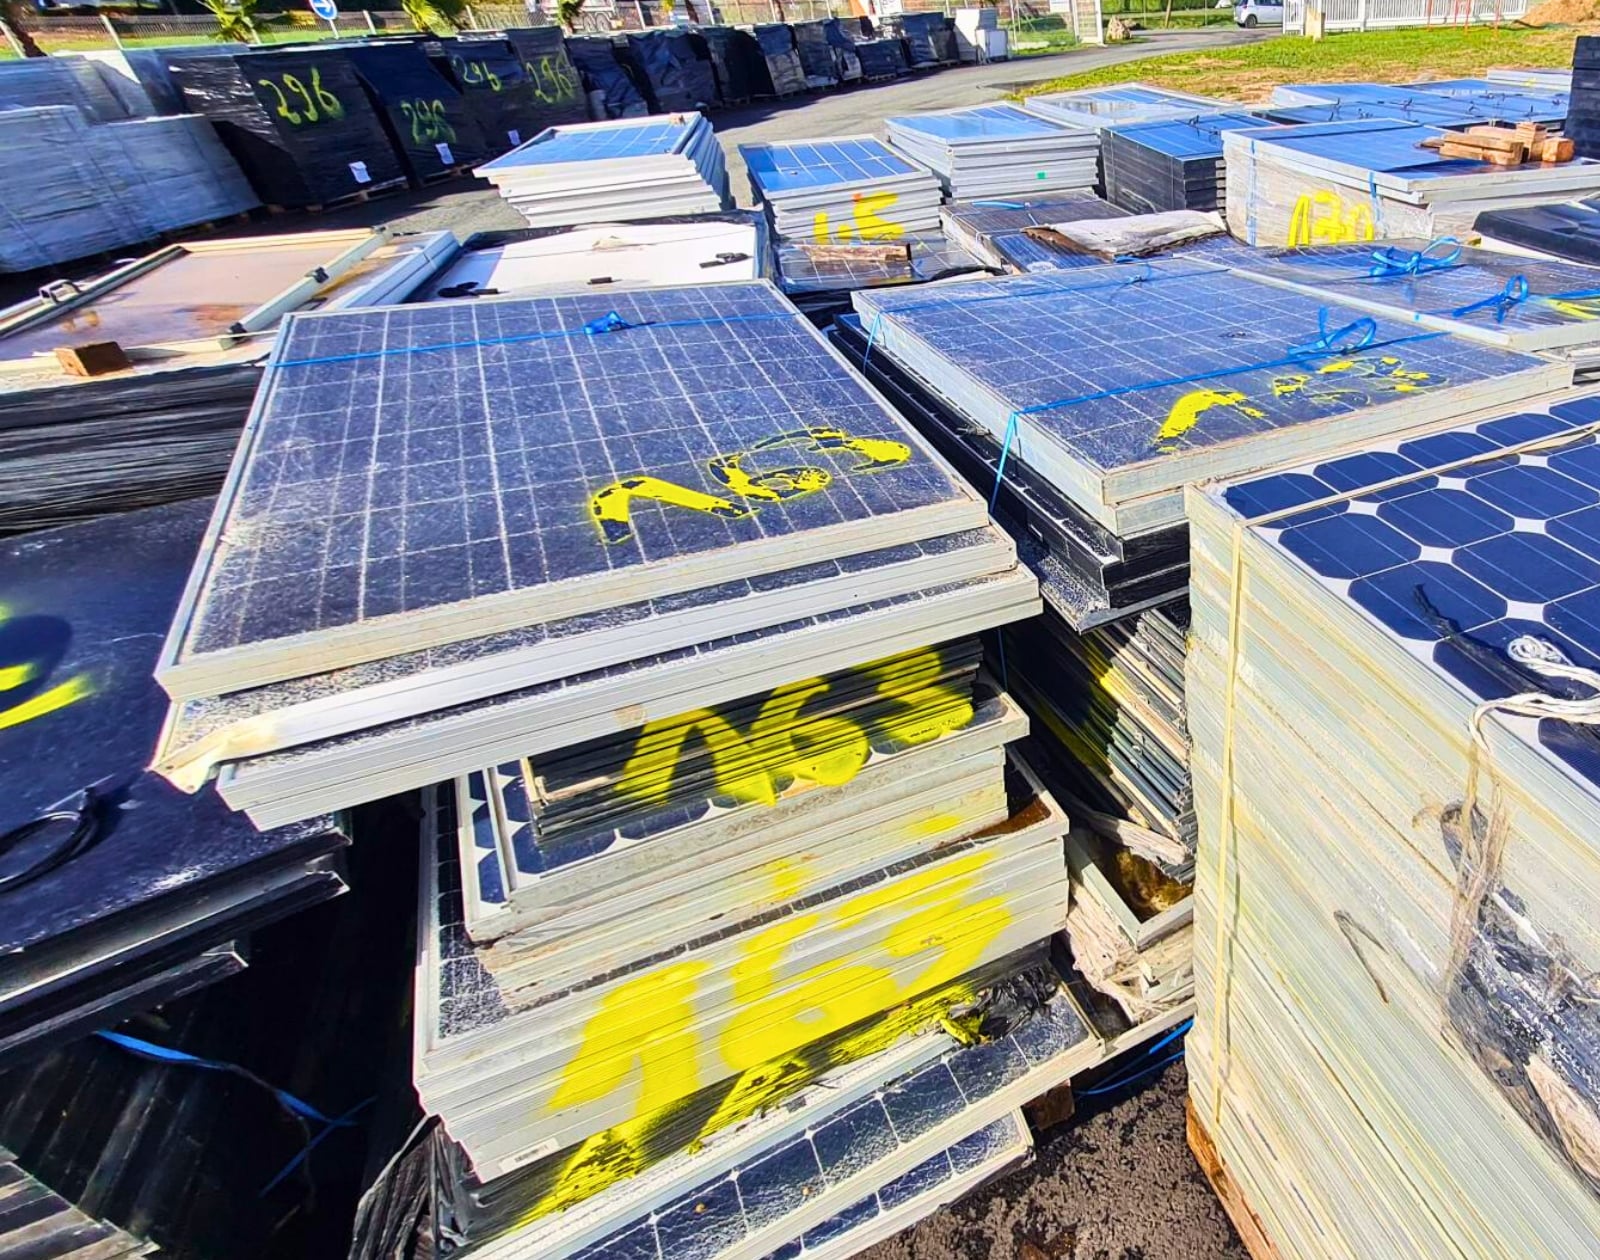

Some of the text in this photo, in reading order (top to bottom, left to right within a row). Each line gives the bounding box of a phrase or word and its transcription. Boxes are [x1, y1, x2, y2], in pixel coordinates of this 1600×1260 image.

[258, 67, 344, 124] 296
[453, 54, 501, 92] 296
[526, 48, 574, 103] 296
